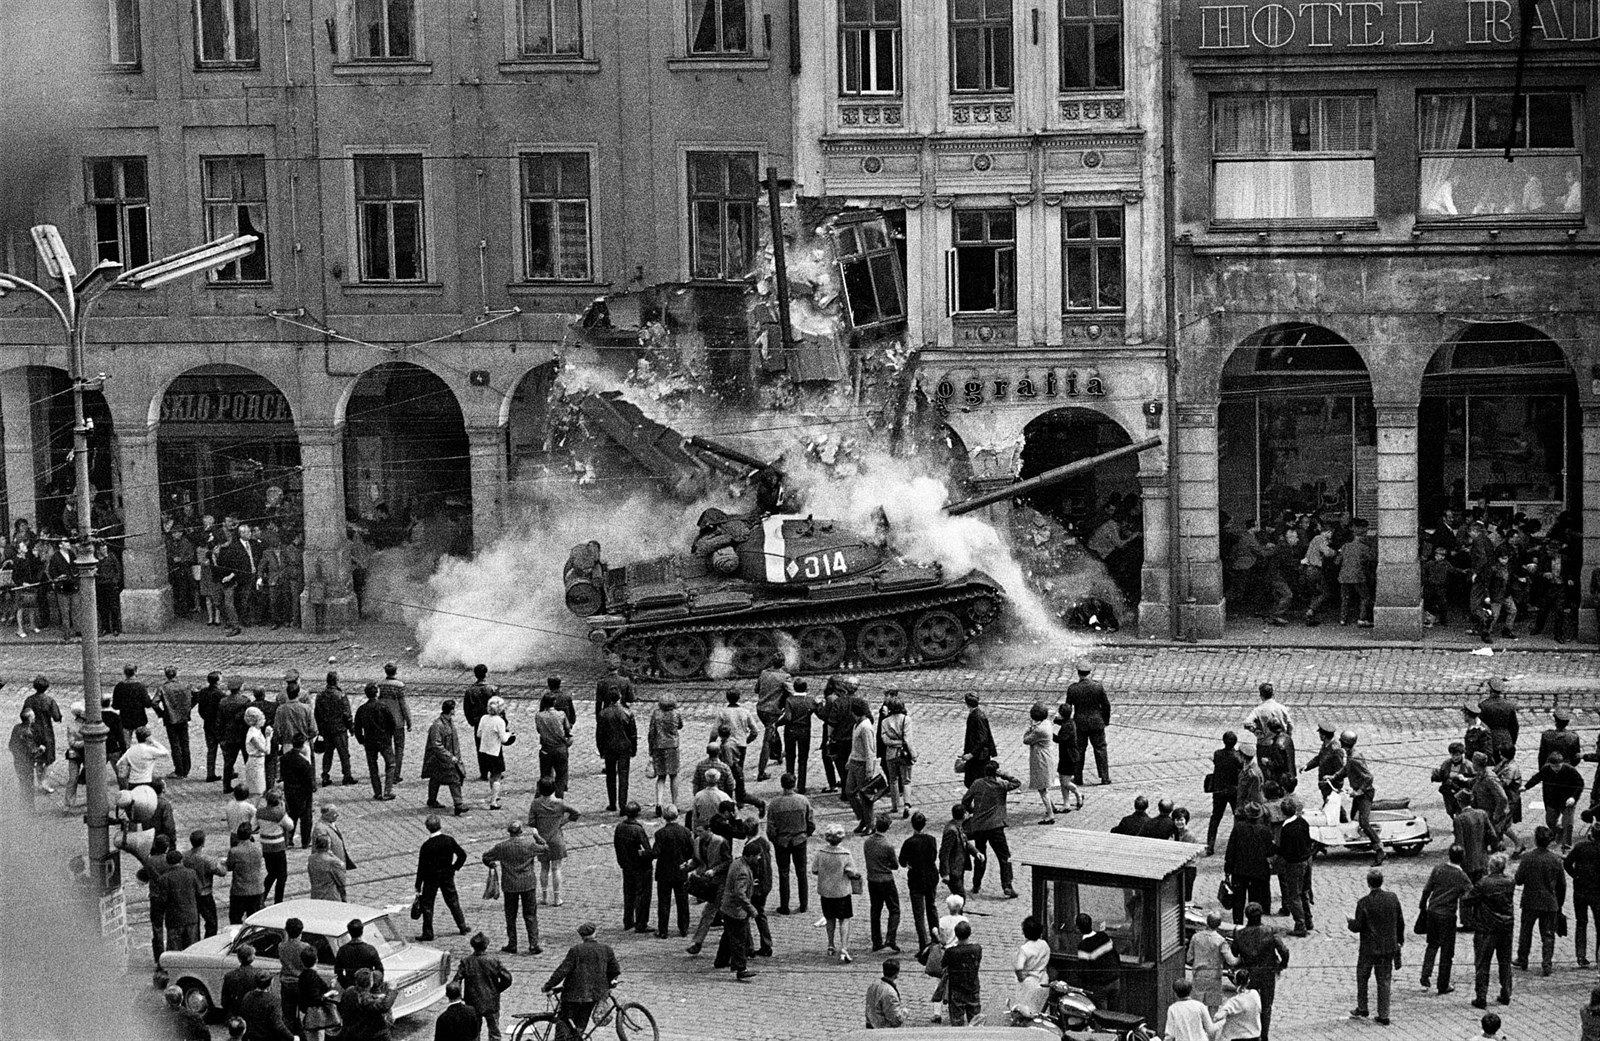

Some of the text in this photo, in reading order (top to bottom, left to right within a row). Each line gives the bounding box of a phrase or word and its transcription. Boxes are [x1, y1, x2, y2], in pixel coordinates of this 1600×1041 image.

[1199, 1, 1434, 49] HOTEL
[937, 371, 1106, 405] ografia
[1149, 403, 1156, 413] 5
